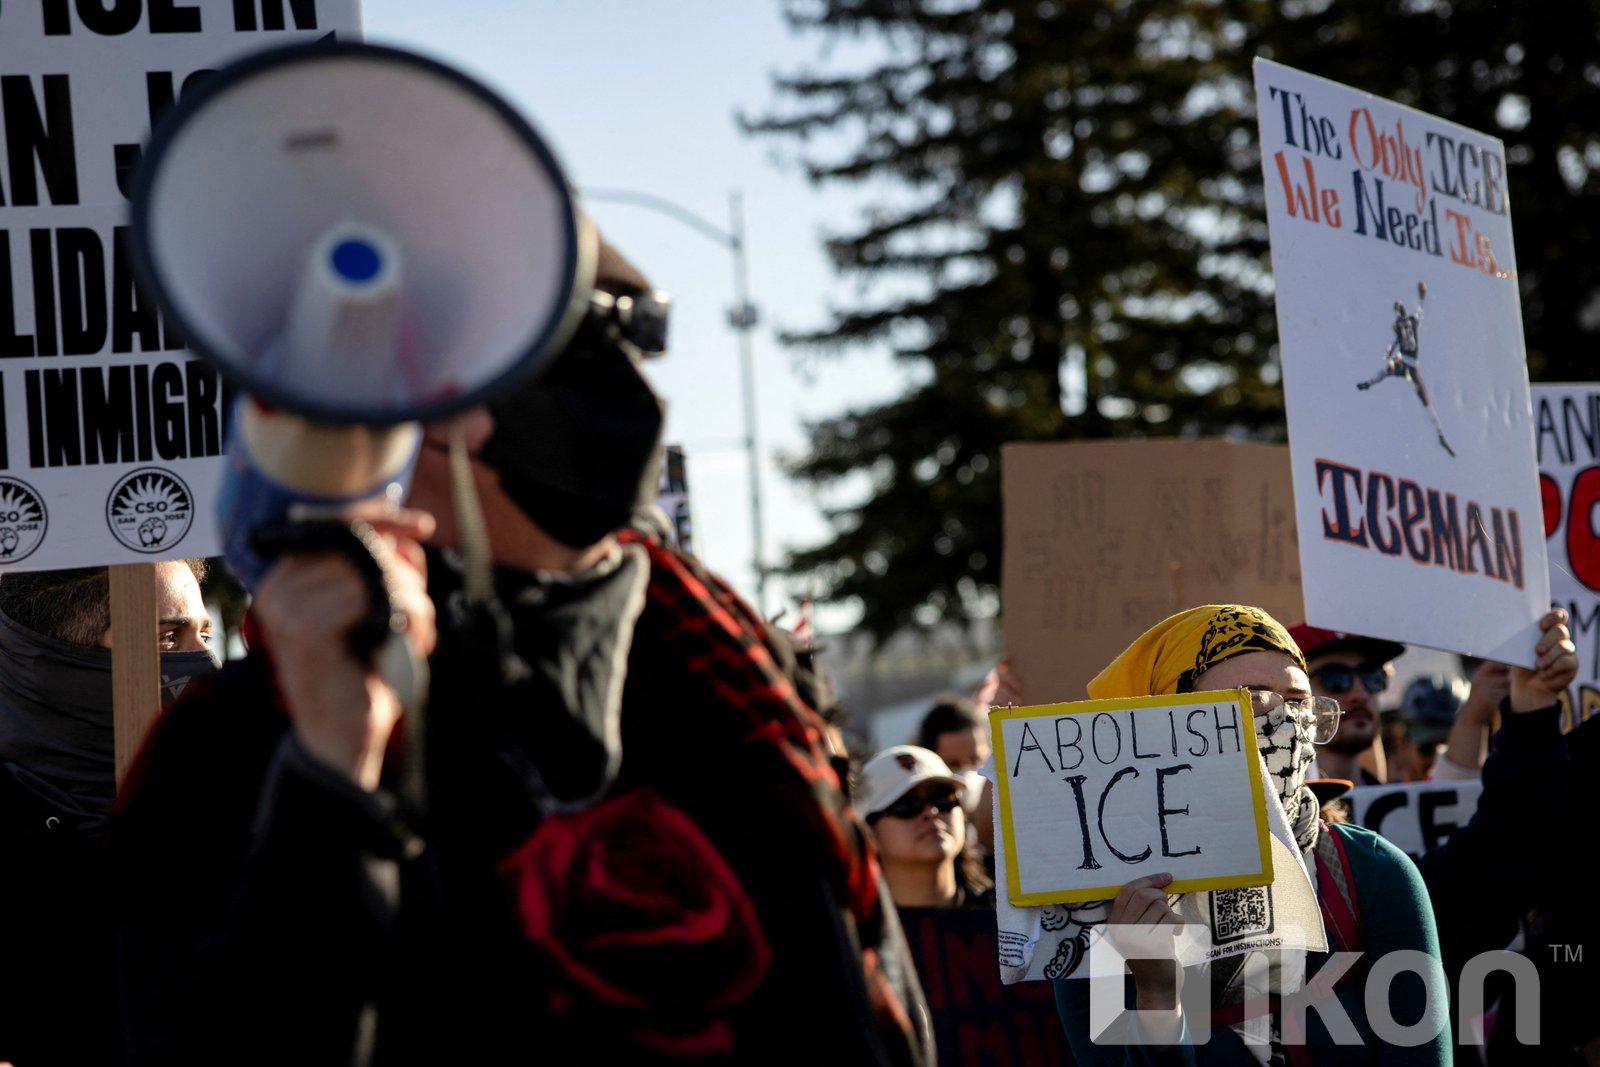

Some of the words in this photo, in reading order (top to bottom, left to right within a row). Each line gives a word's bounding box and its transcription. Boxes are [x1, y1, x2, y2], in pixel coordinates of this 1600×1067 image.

[1269, 86, 1342, 160] The
[1349, 107, 1427, 214] Only
[1426, 131, 1507, 216] ICE
[1274, 152, 1342, 229] We
[1352, 169, 1443, 257] Need
[0, 225, 190, 358] LIDA
[25, 361, 231, 468] INMIGR
[135, 501, 168, 513] CSO
[1013, 704, 1241, 777] ABOLISH
[1062, 764, 1222, 870] ICE
[1205, 946, 1222, 960] SCAN
[1222, 944, 1234, 956] FOR
